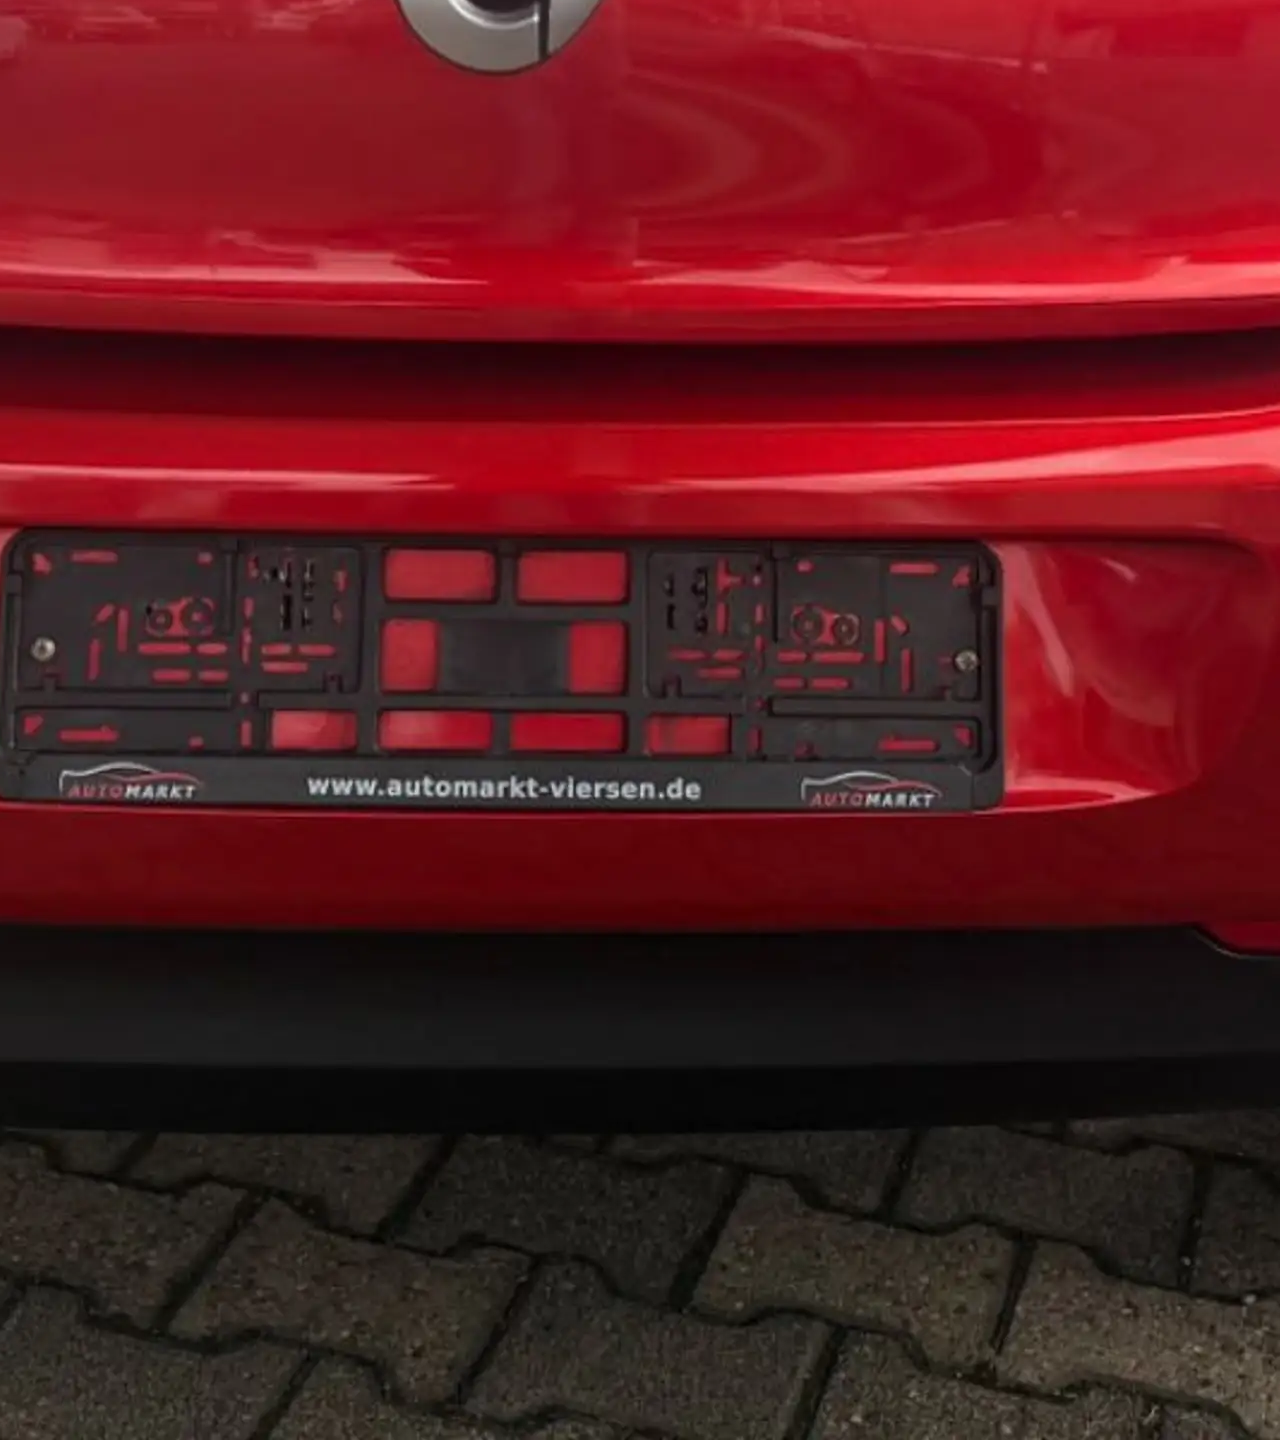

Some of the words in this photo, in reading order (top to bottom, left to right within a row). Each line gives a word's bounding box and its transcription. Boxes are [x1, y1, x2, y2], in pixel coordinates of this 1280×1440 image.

[67, 783, 197, 800] AUTOMARKT
[306, 775, 703, 801] www.automarkt-viersen.de
[809, 791, 935, 808] AUTOMARKT
